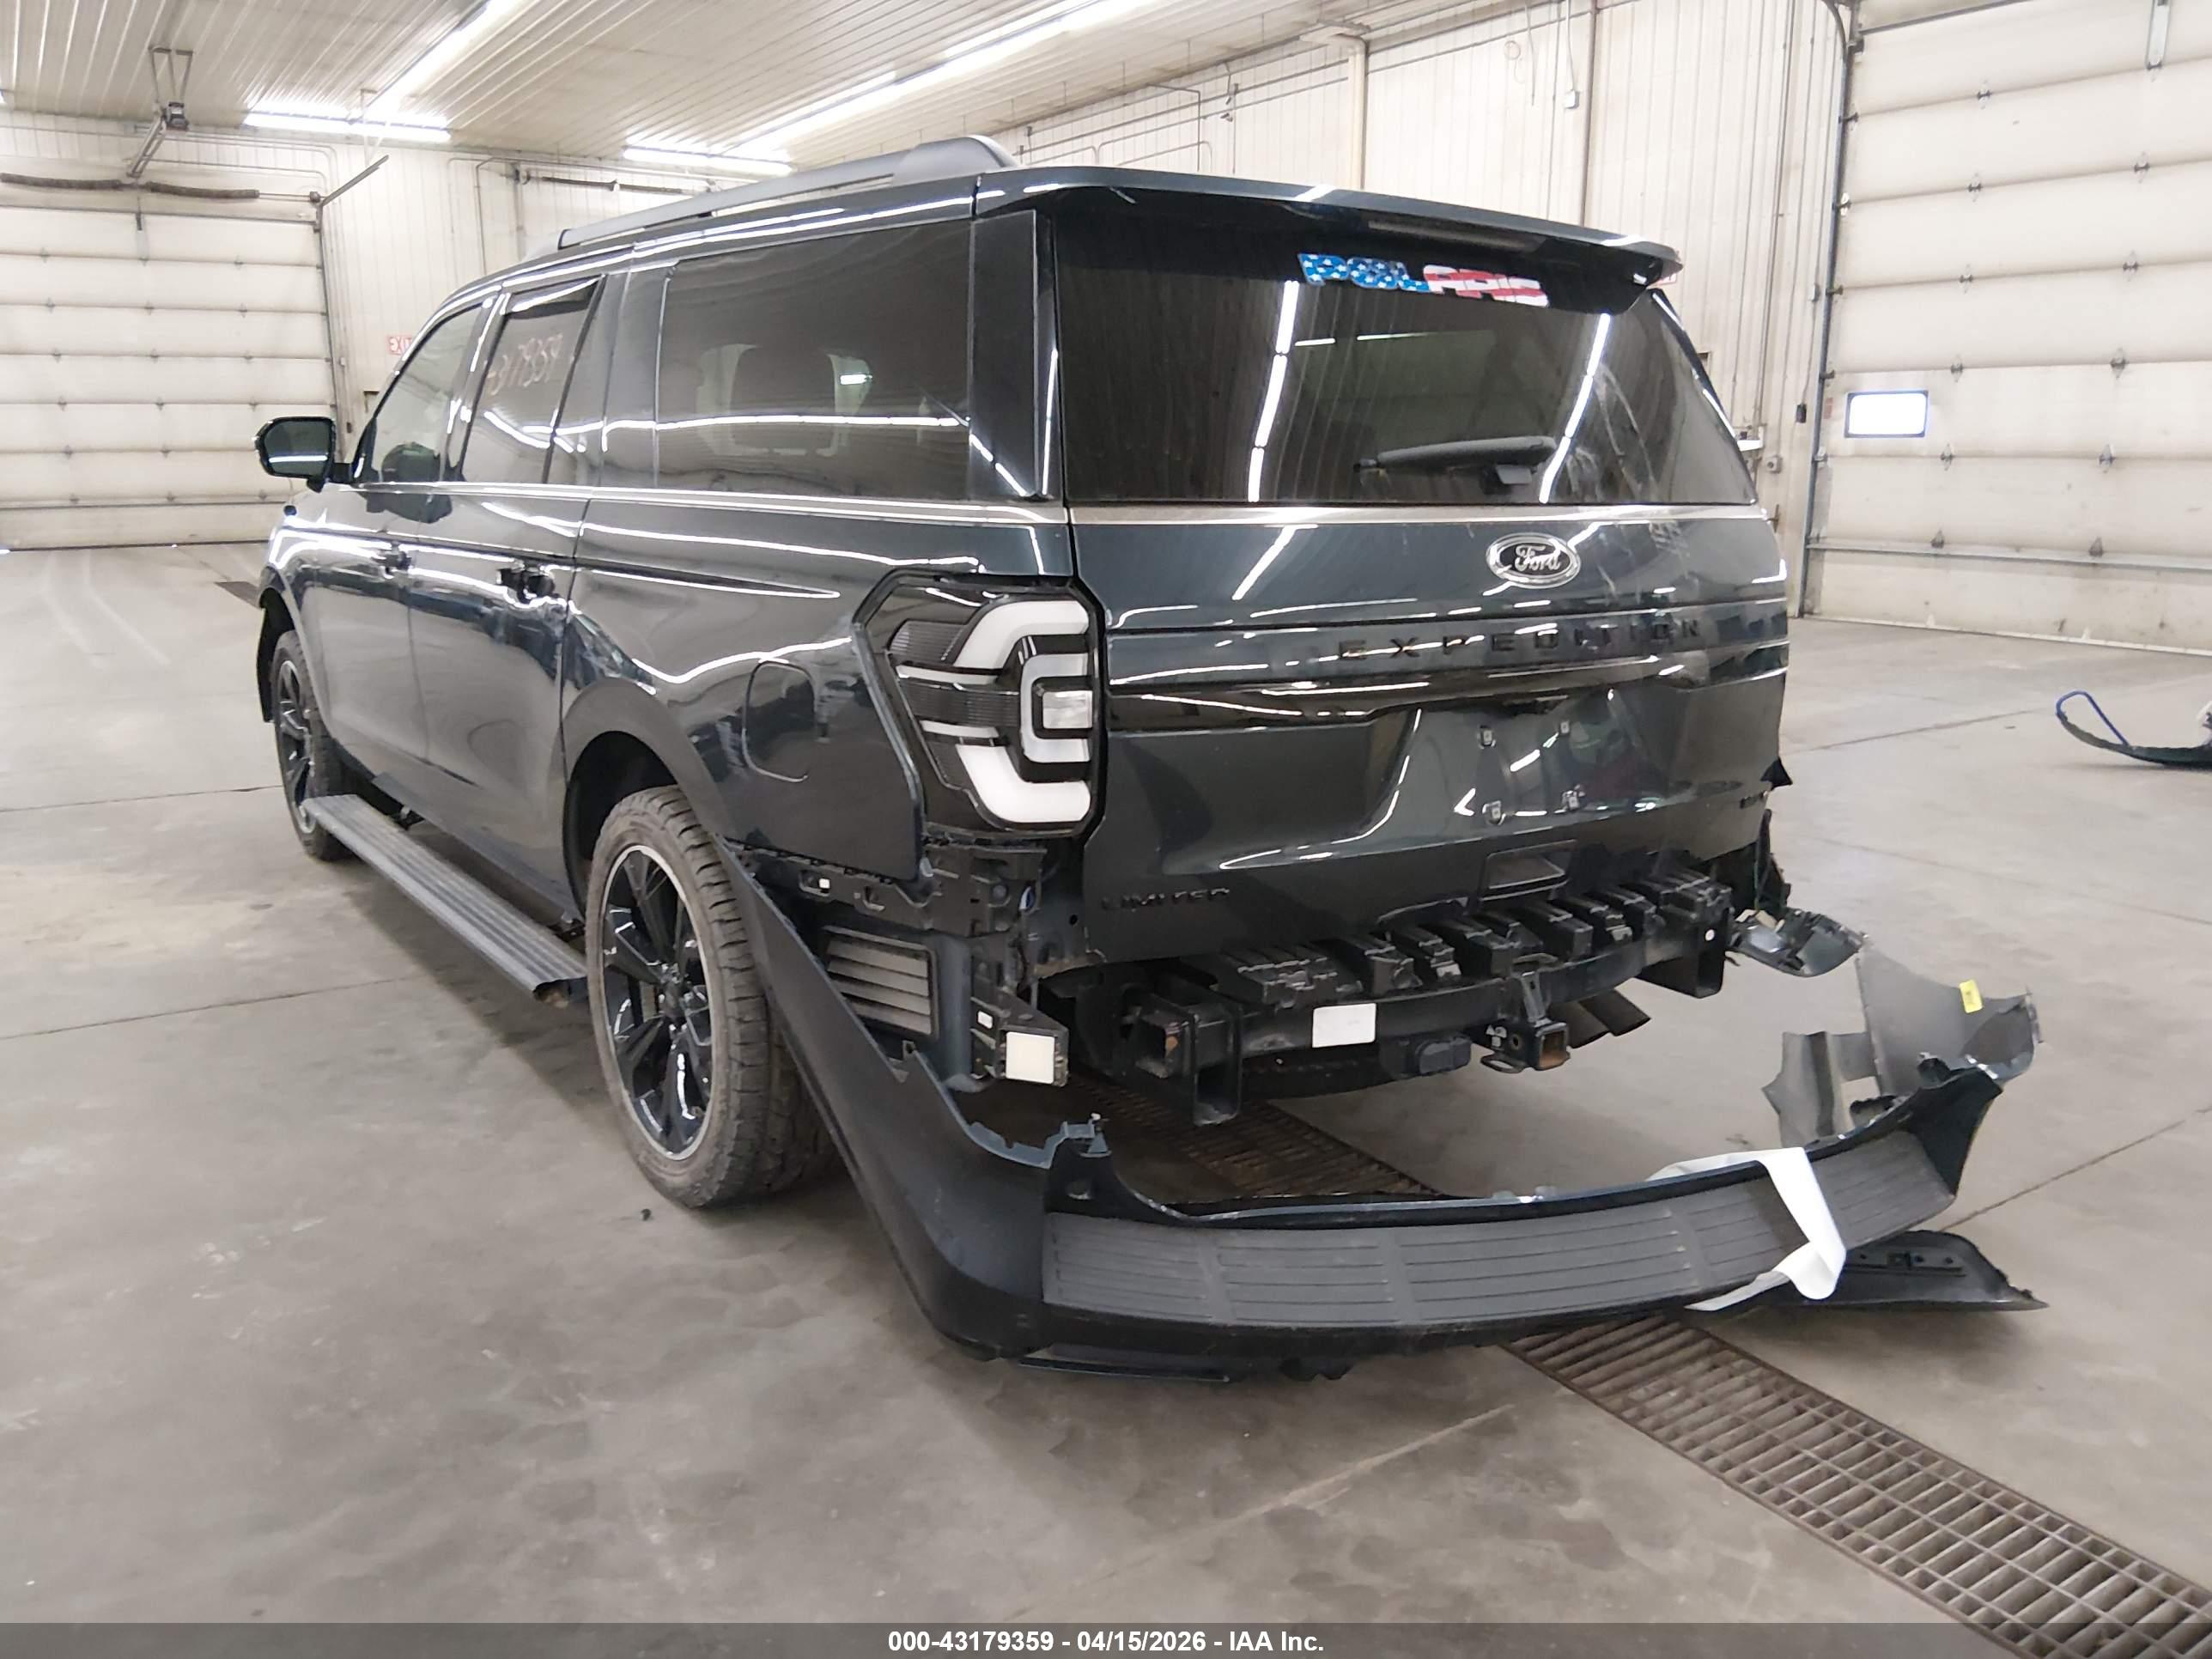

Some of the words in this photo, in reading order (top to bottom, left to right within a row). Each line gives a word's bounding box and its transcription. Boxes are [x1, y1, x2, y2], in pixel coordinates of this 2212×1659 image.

[1297, 252, 1549, 308] POLARIS
[1514, 544, 1562, 572] Ford
[1338, 619, 1700, 660] EXPEDITION
